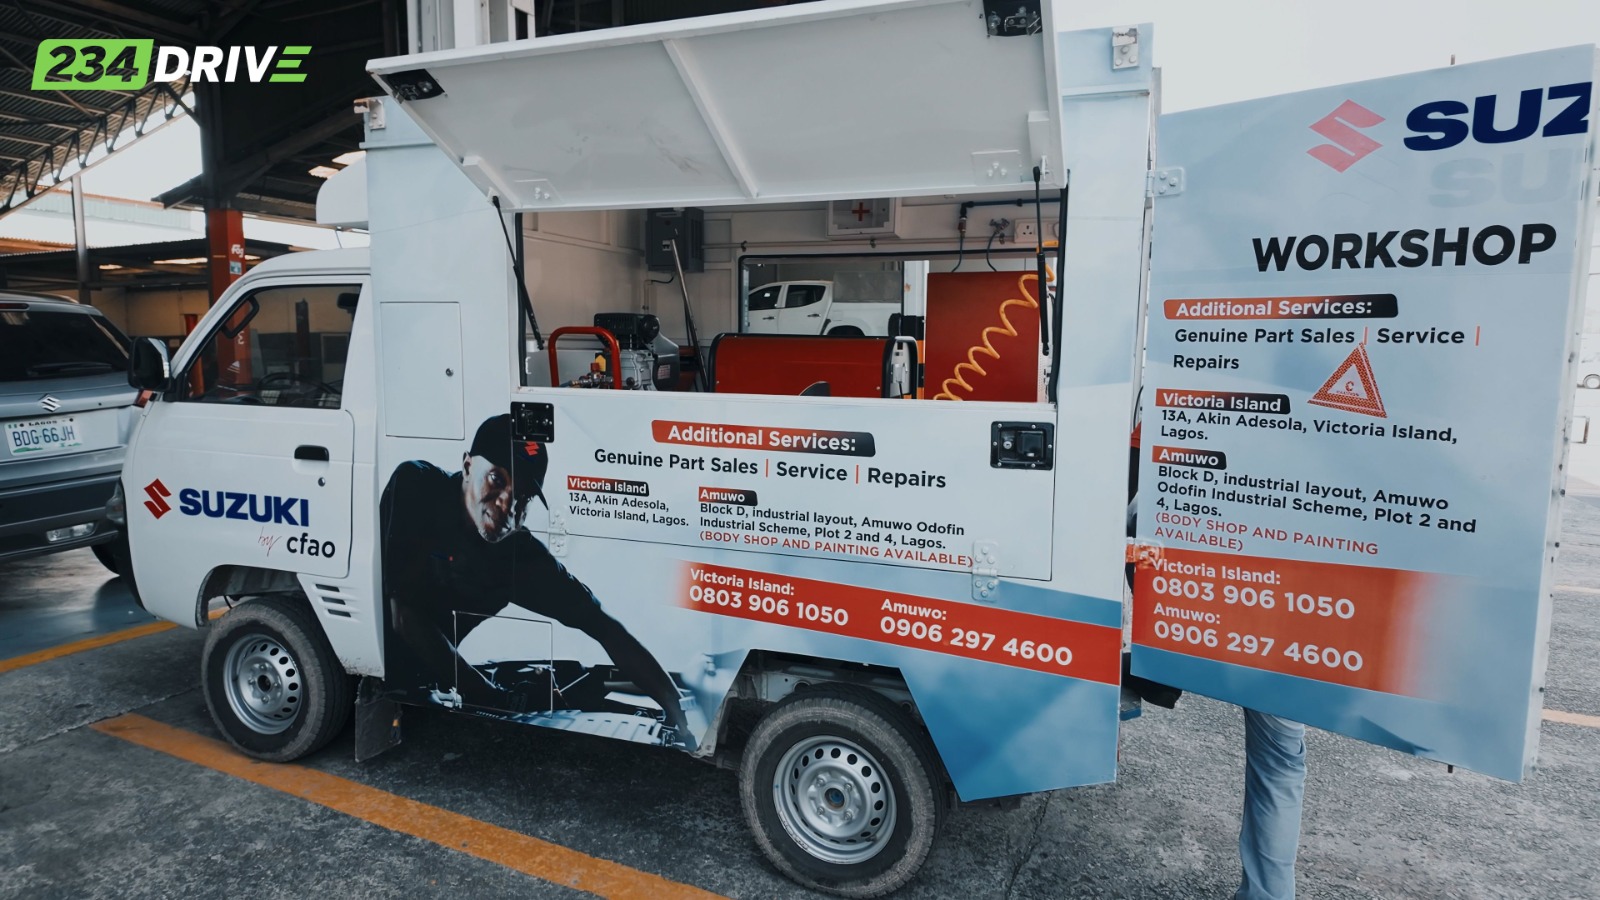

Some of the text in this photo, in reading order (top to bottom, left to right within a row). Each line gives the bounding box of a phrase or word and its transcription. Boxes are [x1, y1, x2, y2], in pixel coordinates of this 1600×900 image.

[1252, 223, 1557, 272] WORKSHOP
[1175, 299, 1372, 317] Additional Services:
[1174, 328, 1465, 344] Genuine Part Sales Service
[1173, 354, 1239, 371] Repairs
[1162, 393, 1281, 412] Victoria Island
[668, 425, 856, 452] Additional Services:
[1161, 425, 1208, 441] Lagos.
[1162, 410, 1457, 444] 13A, Akin Adesola, Victoria Island,
[595, 449, 946, 488] Genuine Part Sales Service Repairs
[1159, 449, 1219, 466] Amuwo
[569, 478, 647, 494] Victoria Island
[700, 489, 745, 503] Amuwo
[1158, 466, 1449, 510] Block D, industrial layout, Amuwo
[179, 488, 309, 527] SUZUKI
[569, 492, 669, 512] 13A, Akin Adesola,
[1156, 498, 1222, 518] 4, Lagos.
[1157, 482, 1477, 533] Odofin Industrial Scheme, Plot 2 and
[569, 506, 689, 527] Victoria Island, Lagos.
[700, 503, 965, 536] Block D, industrial layout, Amuwo Odofin
[286, 532, 336, 558] cfao
[700, 517, 946, 550] Industrial Scheme, Plot 2 and 4, Lagos.
[1154, 526, 1243, 551] AVAILABLE)
[1155, 511, 1379, 555] (BODY SHOP AND PAINTING
[700, 531, 973, 568] (BODY SHOP AND PAINTING AVAILABLE)
[690, 569, 794, 596] Victoria Island:
[1151, 558, 1280, 585] Victoria Island:
[689, 585, 849, 627] 0803 906 1050
[880, 598, 947, 621] Amuwo:
[1152, 576, 1355, 619] 0803 906 1050
[1153, 602, 1220, 624] Amuwo:
[880, 615, 1073, 667] 0906 297 4600
[1154, 620, 1363, 671] 0906 297 4600
